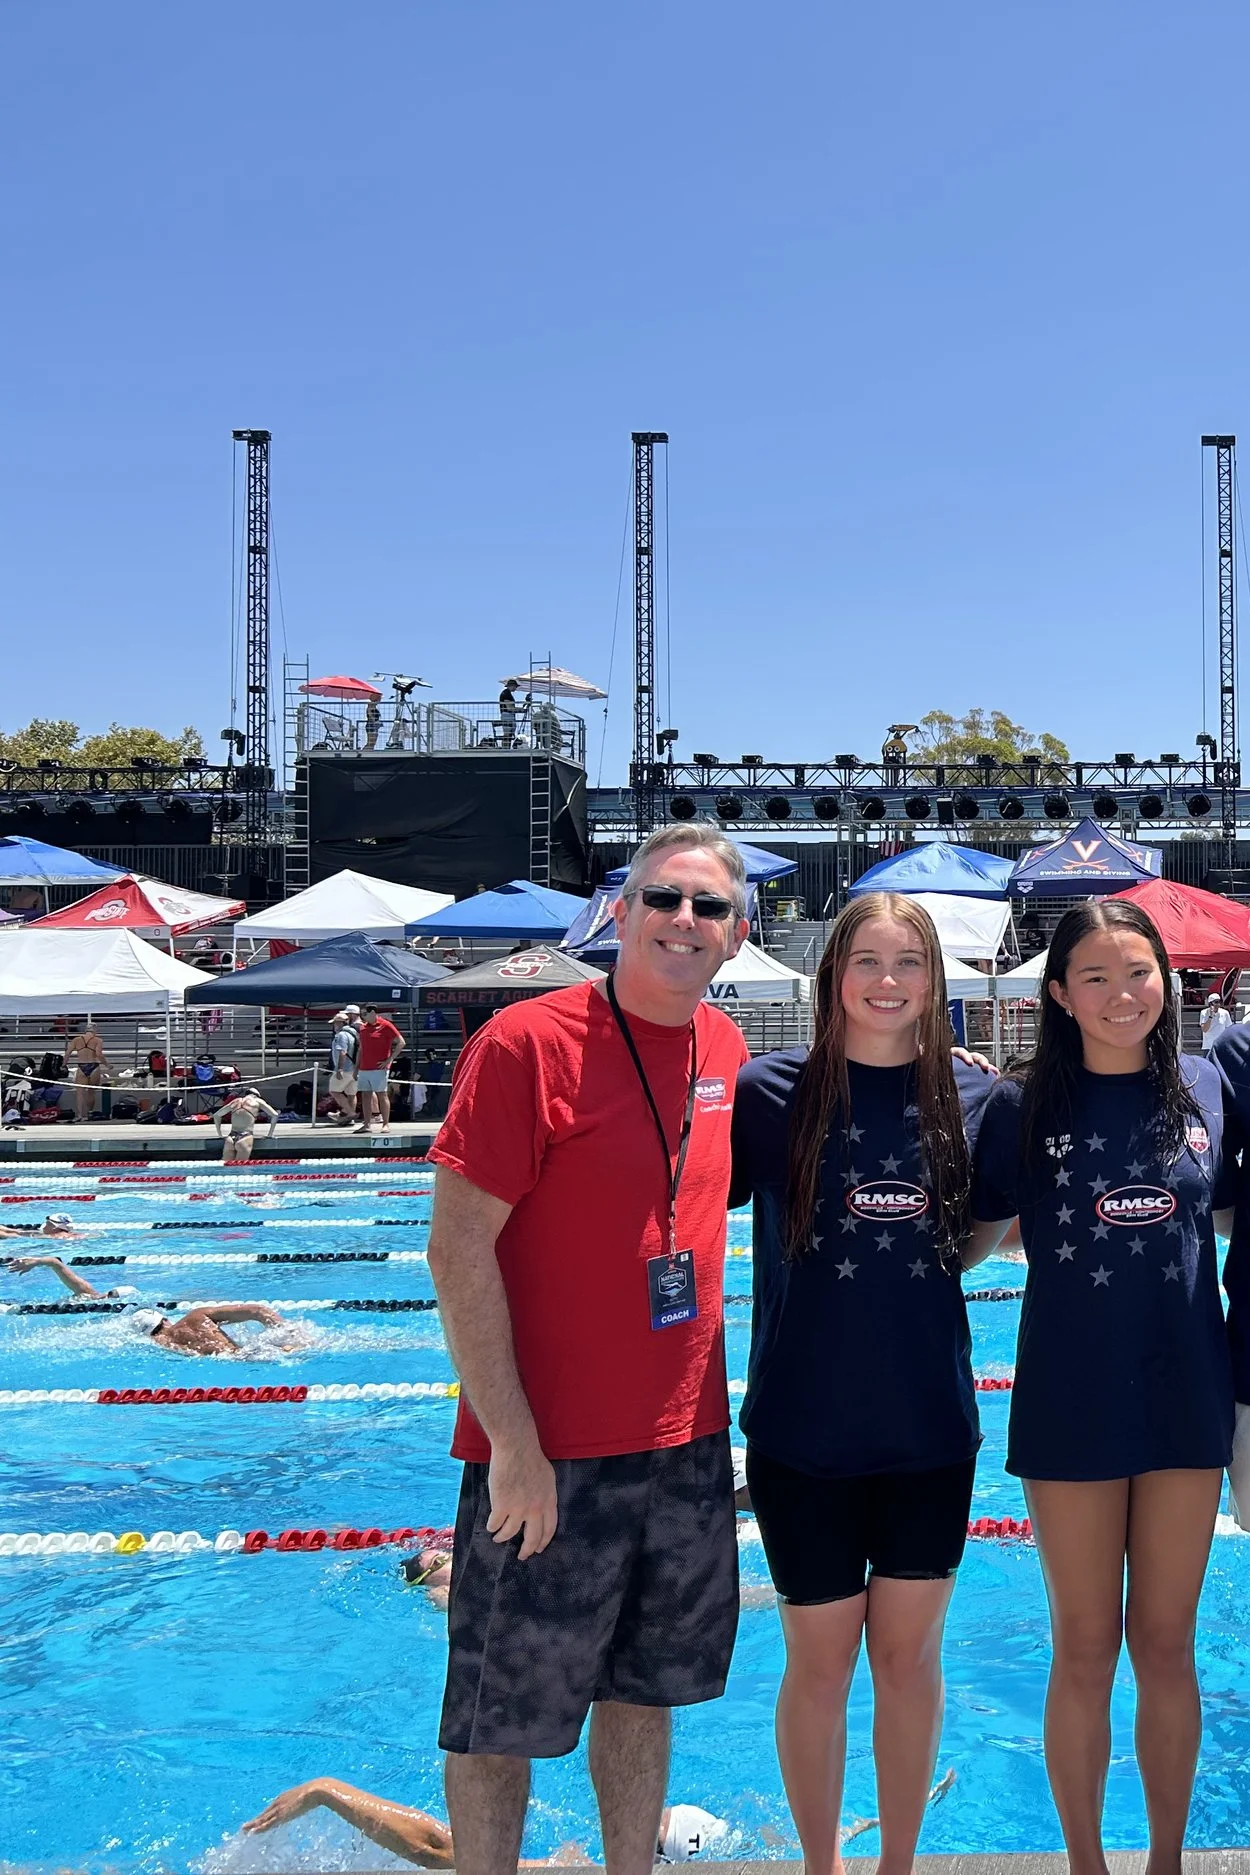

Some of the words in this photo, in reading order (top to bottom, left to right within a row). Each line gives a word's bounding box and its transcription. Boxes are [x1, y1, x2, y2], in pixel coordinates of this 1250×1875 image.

[1071, 840, 1102, 862] V
[426, 991, 499, 1004] SCARLET
[501, 990, 543, 1003] AQU
[703, 983, 740, 999] VA
[694, 1083, 725, 1095] RMS
[1045, 1133, 1071, 1146] arna
[853, 1193, 926, 1206] RMSC
[1103, 1196, 1172, 1212] RMSC
[661, 1309, 689, 1324] COACH
